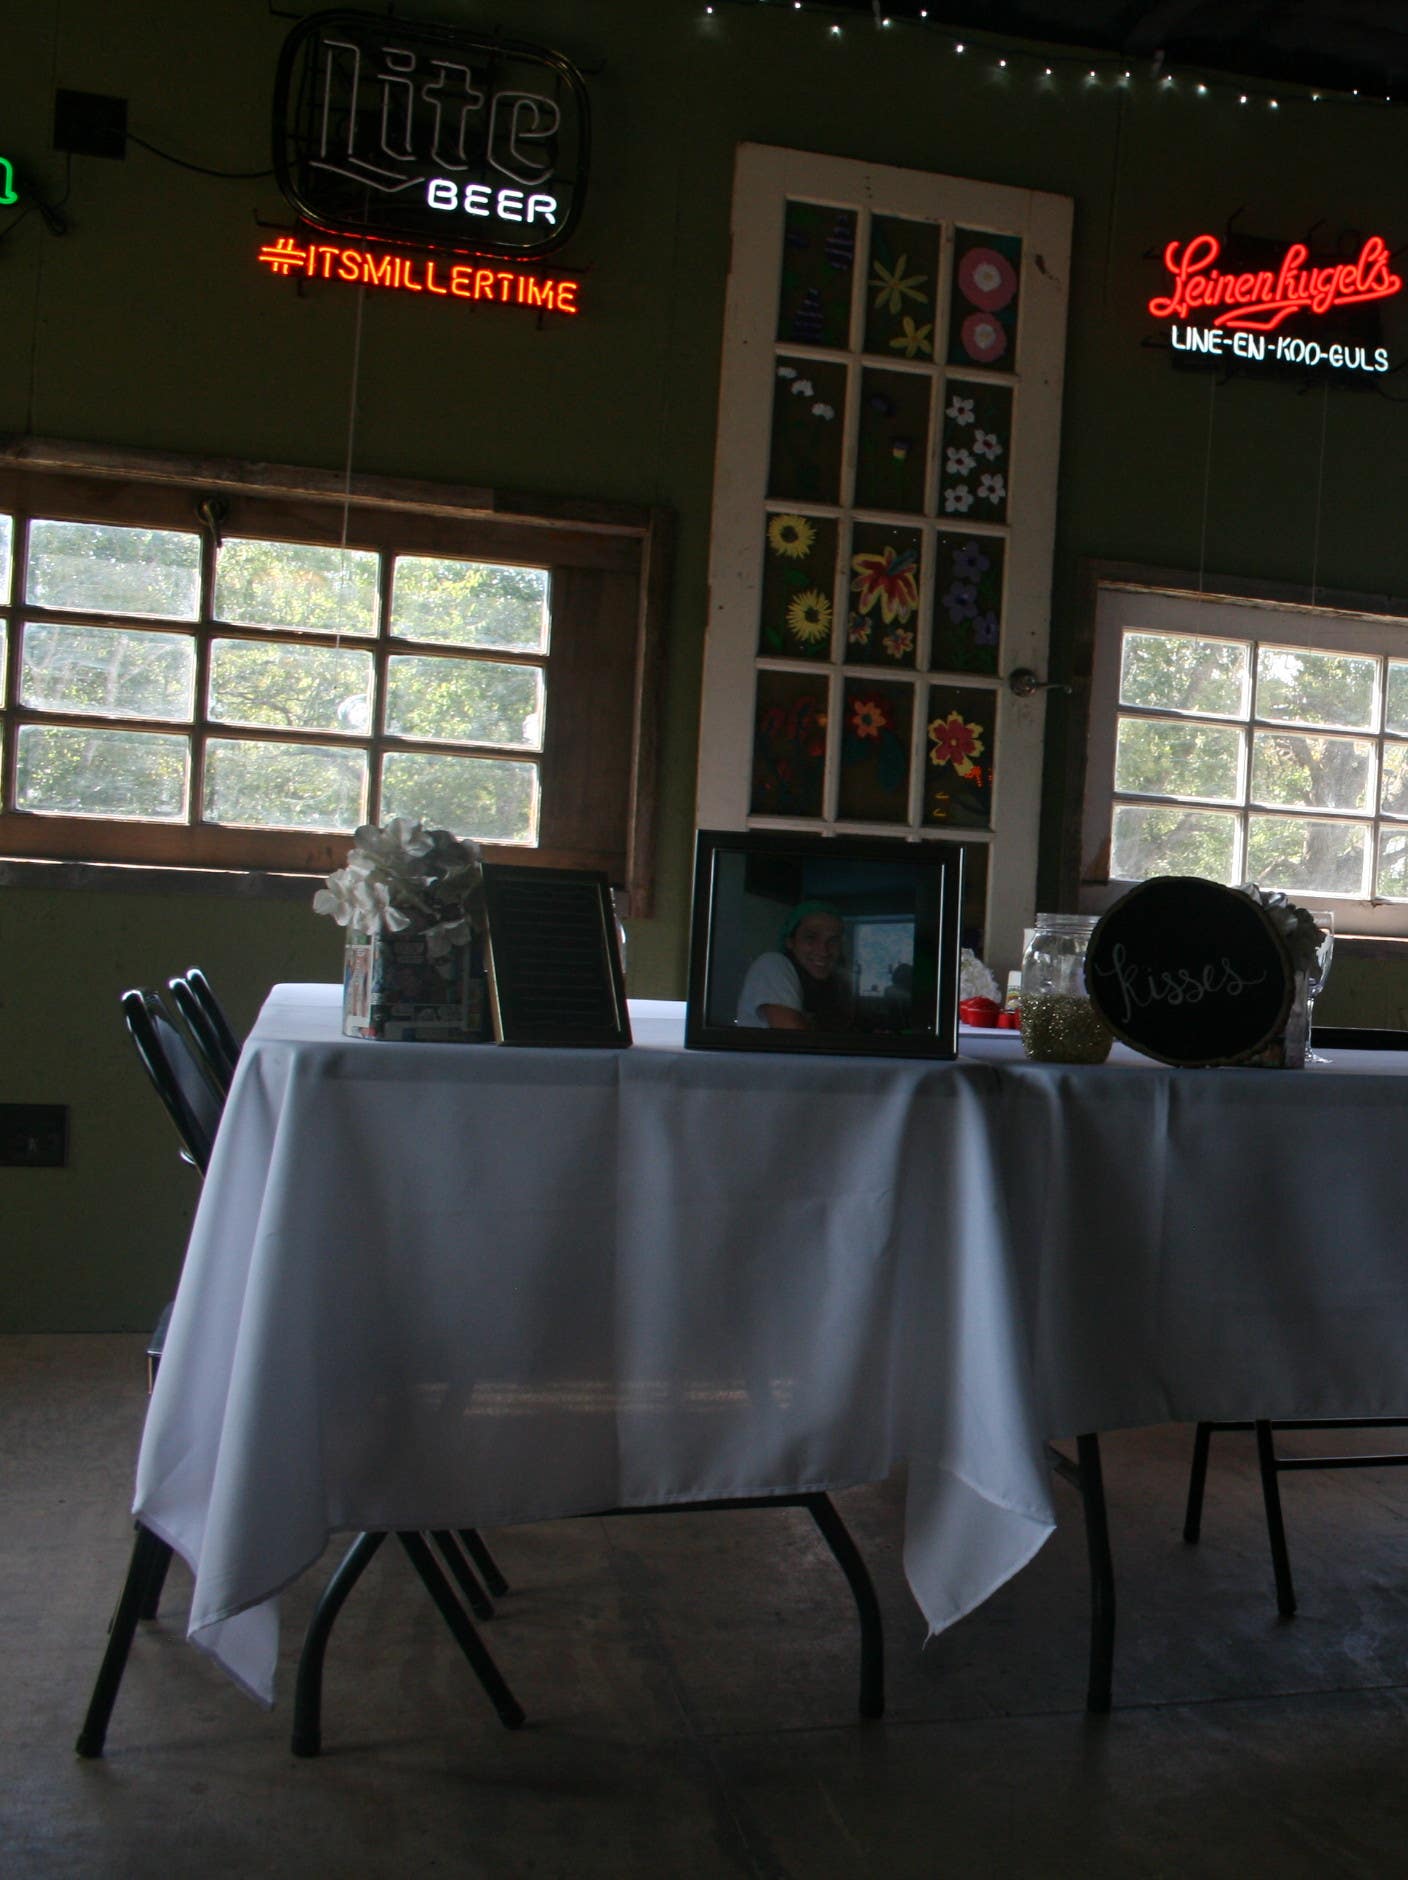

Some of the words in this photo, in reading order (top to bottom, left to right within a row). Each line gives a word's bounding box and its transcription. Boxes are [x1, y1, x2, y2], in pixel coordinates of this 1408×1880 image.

[309, 39, 562, 192] Lite
[426, 177, 559, 226] BEER
[258, 237, 580, 315] #ITSMILLERTIME
[1149, 234, 1402, 331] Leinenkugel's
[1171, 325, 1390, 373] LINE-EN-KOO-GULS
[1094, 943, 1267, 1024] kisses
